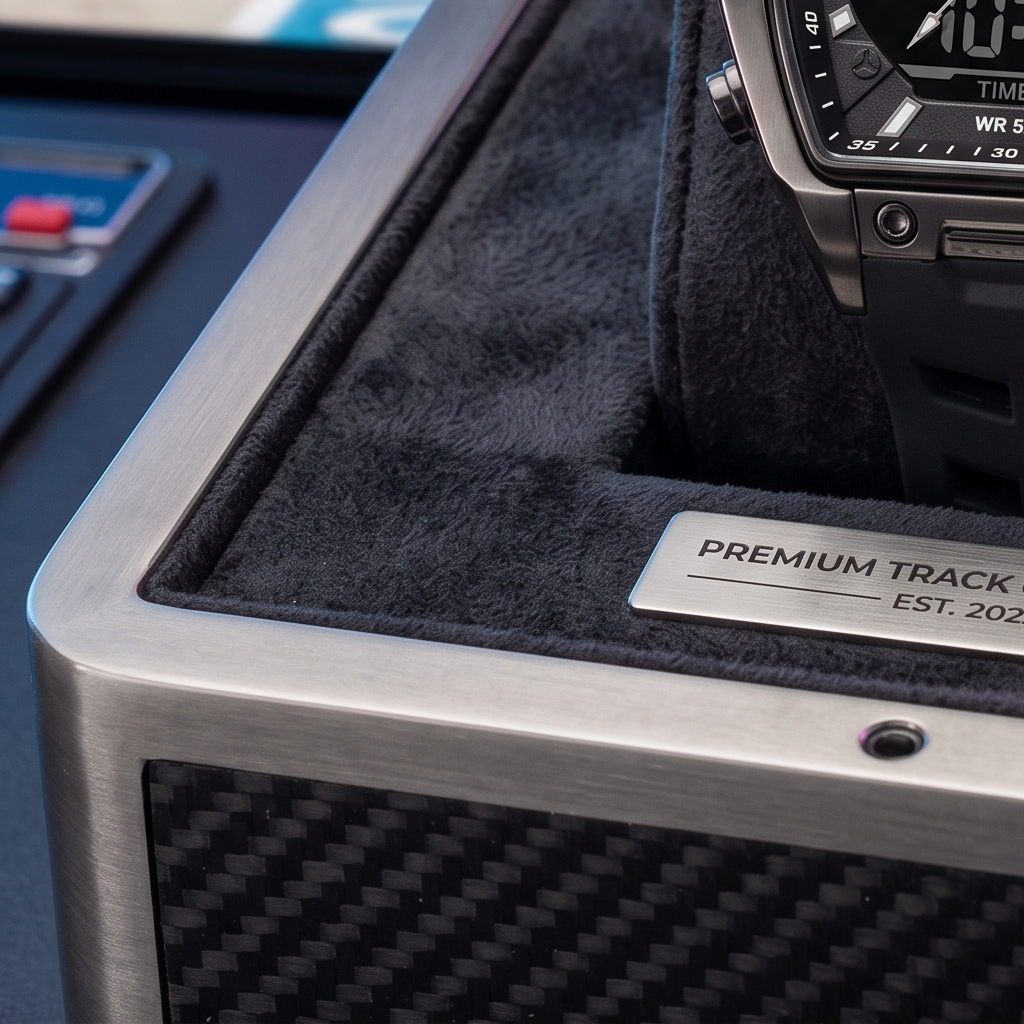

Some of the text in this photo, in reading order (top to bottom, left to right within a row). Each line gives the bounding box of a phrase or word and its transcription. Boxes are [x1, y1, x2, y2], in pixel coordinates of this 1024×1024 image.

[804, 11, 819, 36] 40
[975, 115, 1008, 133] WR
[847, 139, 876, 151] 35
[990, 147, 1017, 159] 30
[697, 538, 877, 578] PREMIUM
[888, 560, 1010, 596] TRACK
[891, 592, 956, 617] EST.
